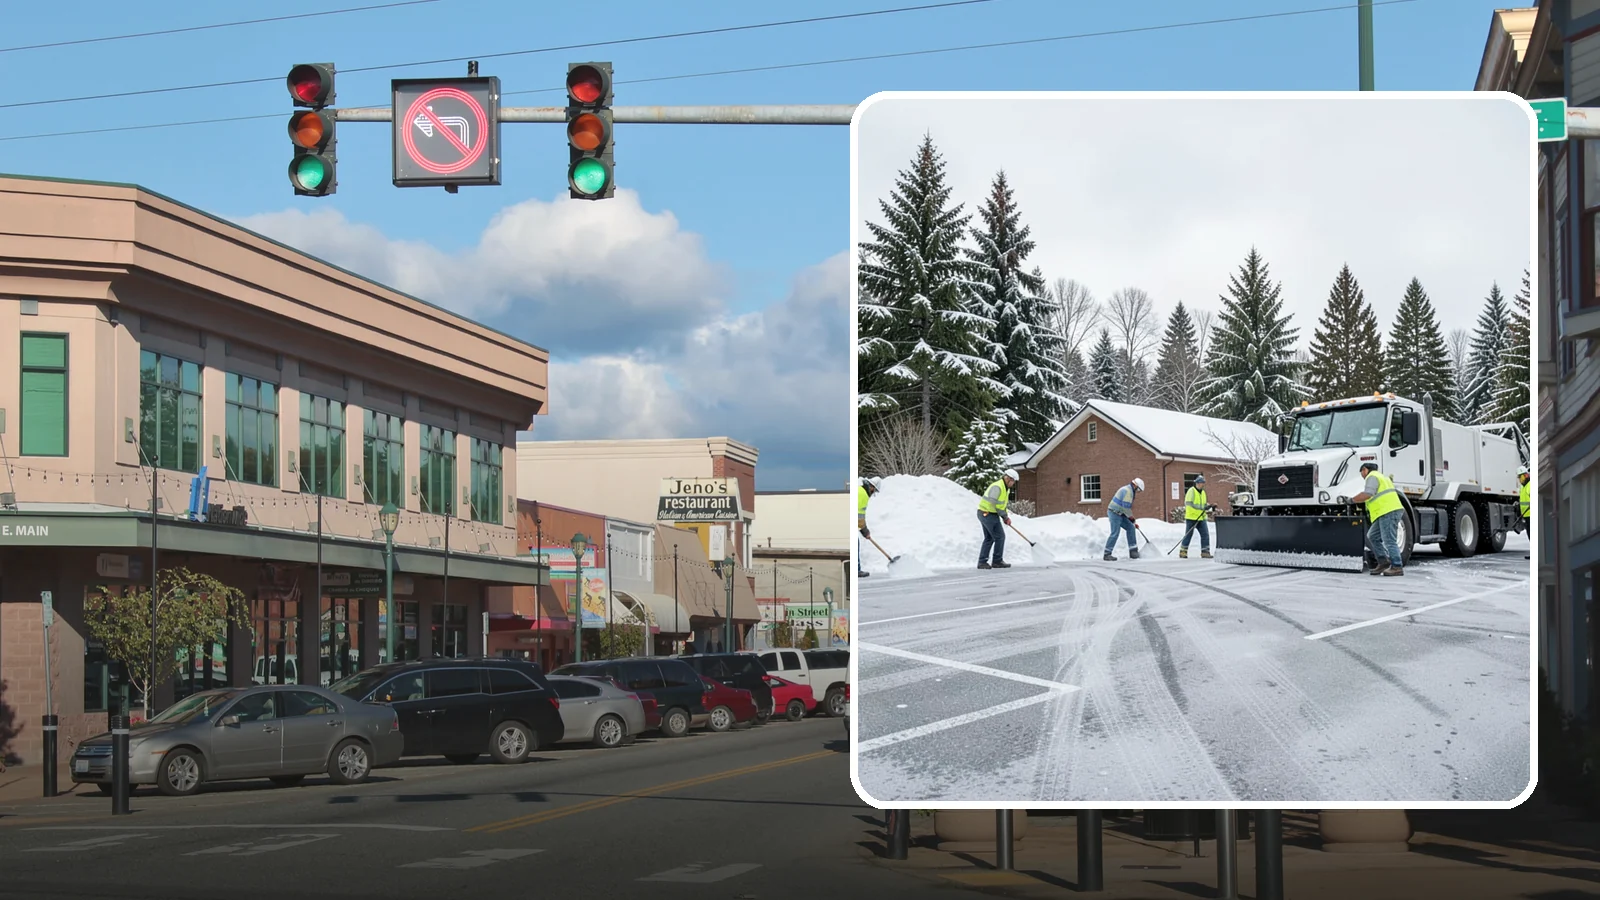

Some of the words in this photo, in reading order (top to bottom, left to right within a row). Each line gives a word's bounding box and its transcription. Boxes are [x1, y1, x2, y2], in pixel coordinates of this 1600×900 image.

[670, 480, 727, 494] Jeno's
[665, 497, 731, 509] restaurant
[658, 509, 681, 519] Italian
[685, 509, 715, 519] American
[714, 509, 738, 519] Cuisine
[2, 525, 13, 536] E.
[15, 525, 49, 536] MAIN
[798, 607, 828, 616] Street
